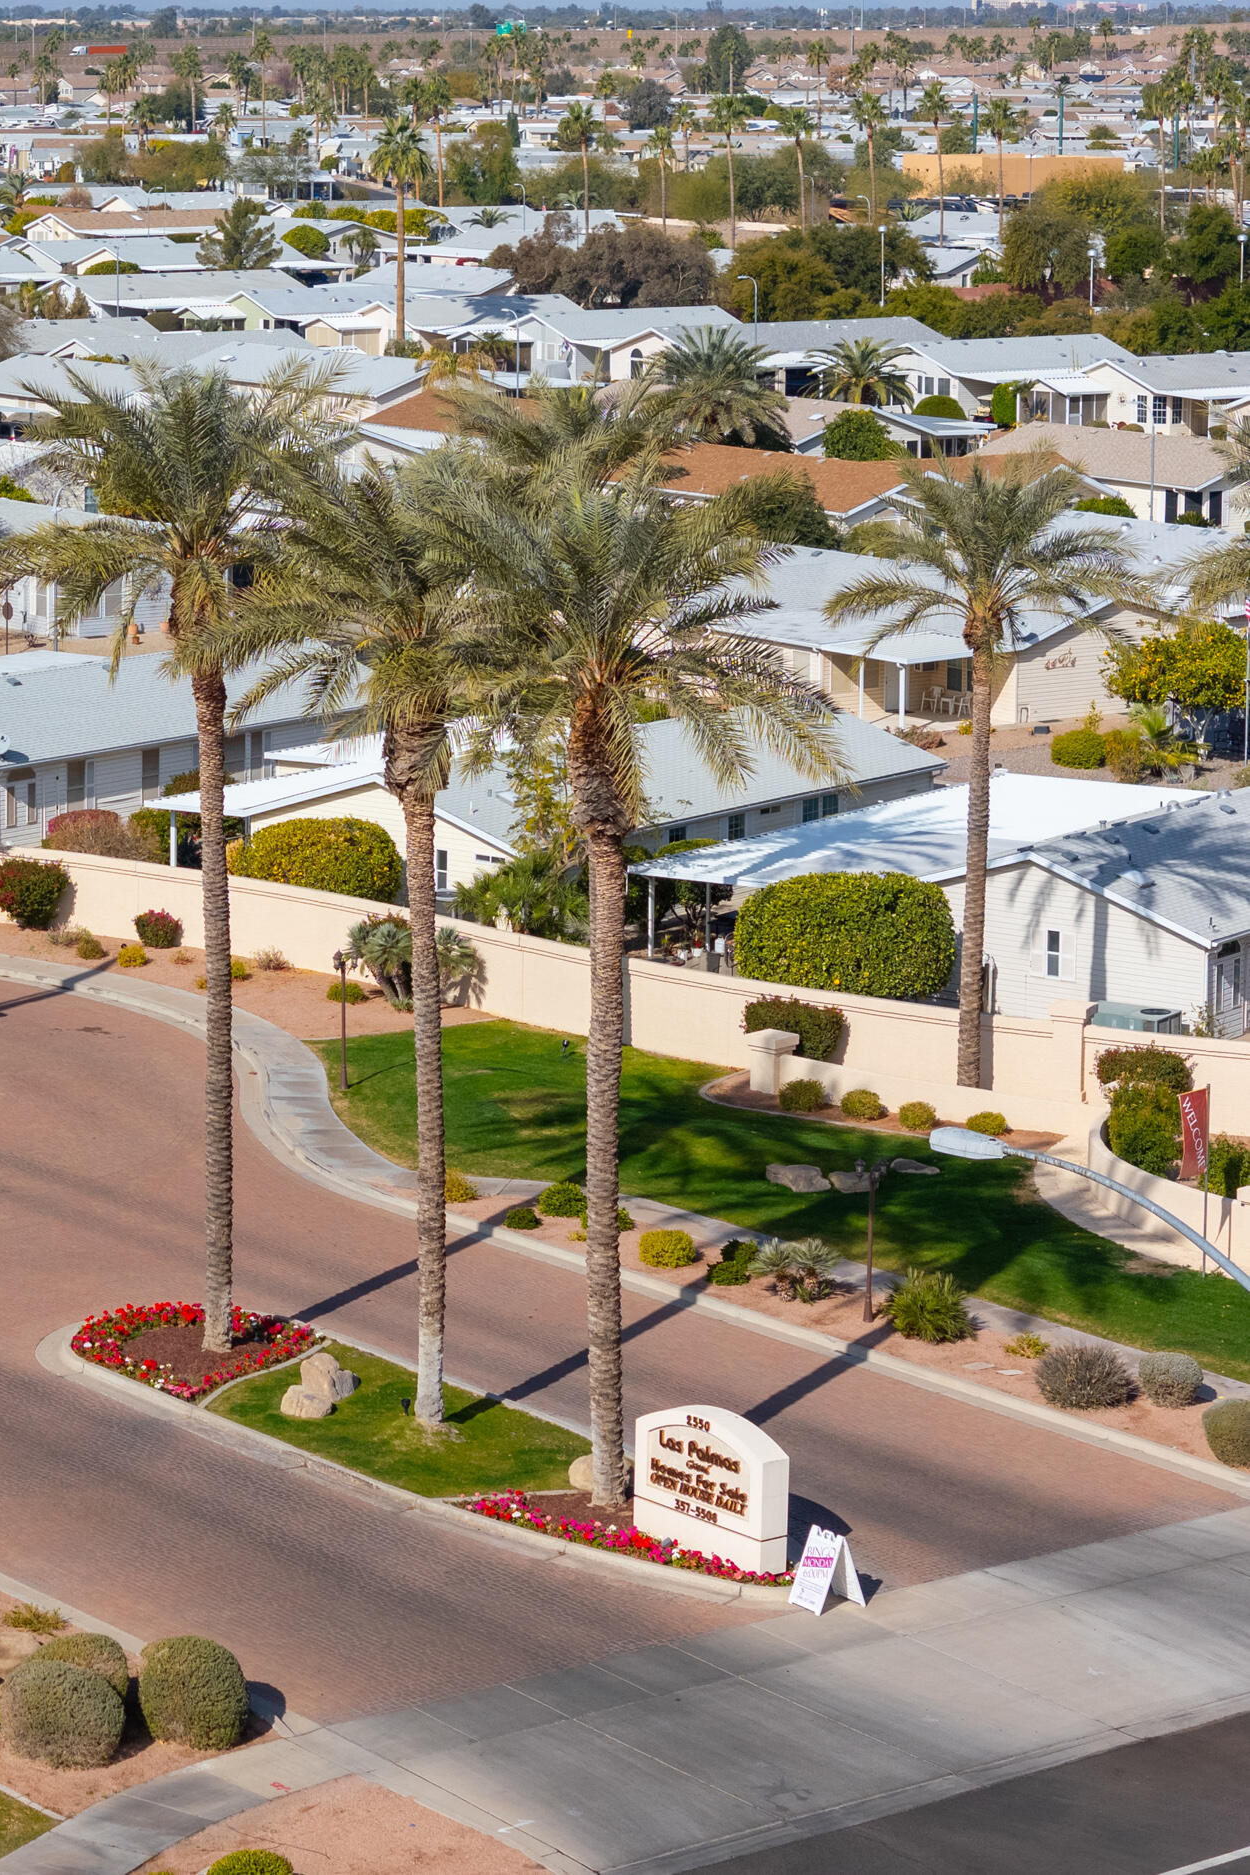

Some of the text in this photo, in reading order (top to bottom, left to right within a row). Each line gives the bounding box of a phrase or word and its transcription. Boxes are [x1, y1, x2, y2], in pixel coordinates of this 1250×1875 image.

[1182, 1097, 1206, 1168] WELCOME
[686, 1415, 710, 1432] 2550
[659, 1429, 740, 1474] Las Palmas
[650, 1457, 748, 1503] Homes For Sale
[650, 1472, 748, 1517] OPEN HOUSE DAILY
[803, 1558, 833, 1568] MONDAY
[806, 1546, 836, 1558] BINGO
